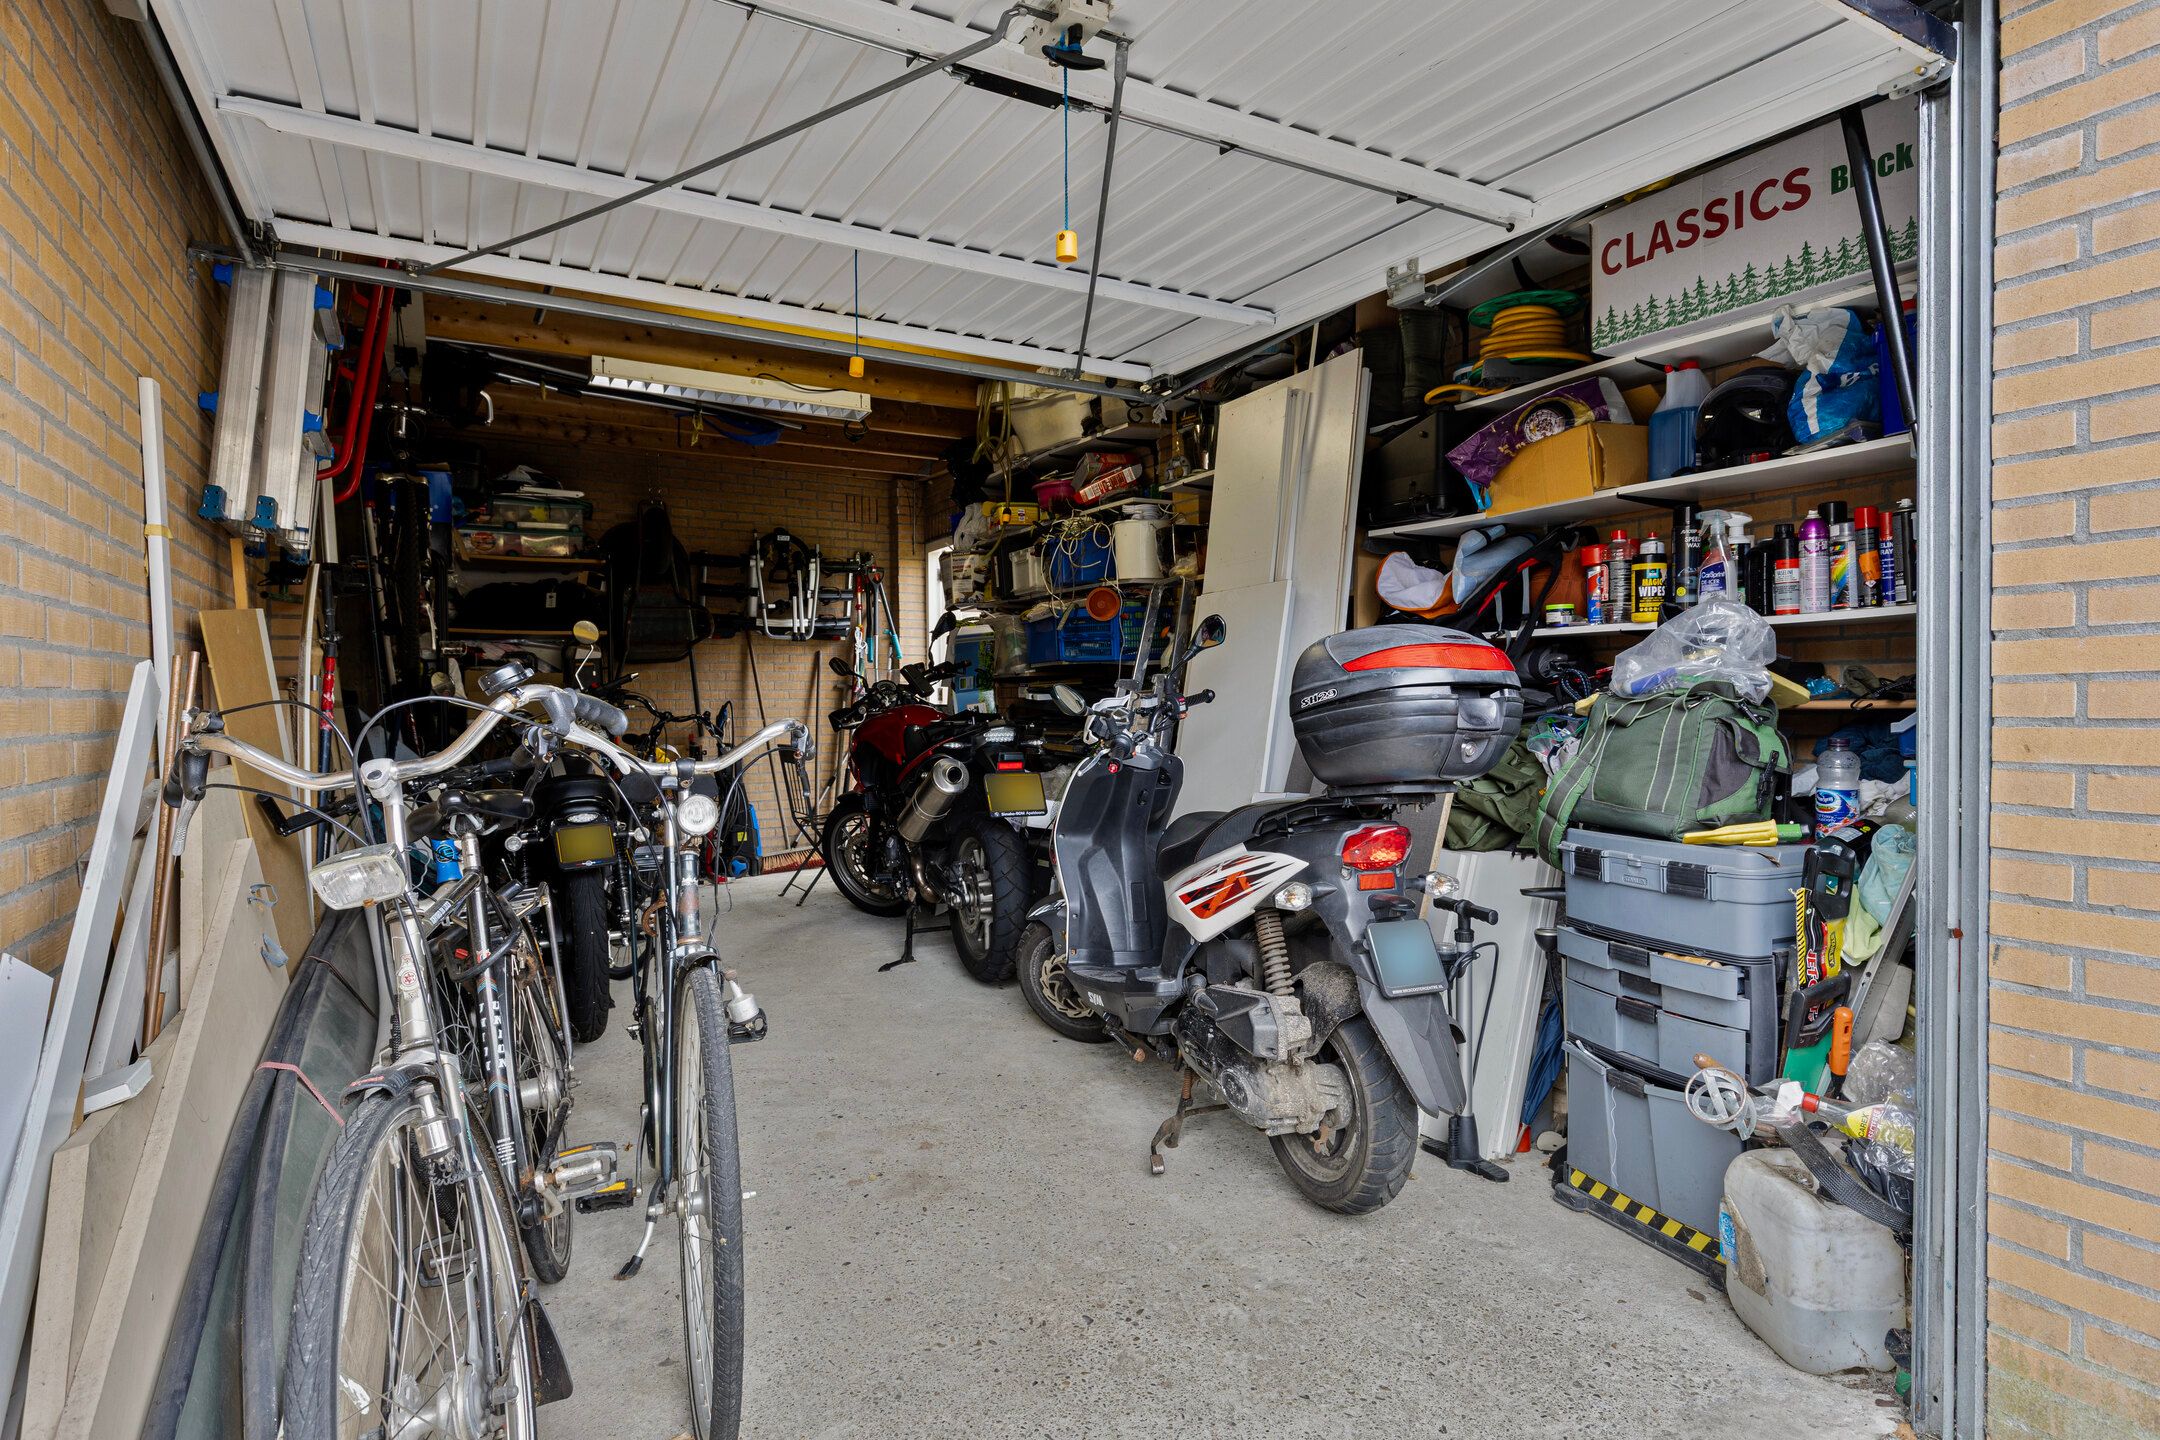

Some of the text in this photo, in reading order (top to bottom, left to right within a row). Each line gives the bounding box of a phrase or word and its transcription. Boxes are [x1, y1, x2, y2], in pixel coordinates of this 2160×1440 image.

[1601, 142, 1915, 276] CLASSICS Bck
[1641, 577, 1662, 586] MAGIC
[1638, 585, 1665, 597] WIPES
[1858, 1113, 1870, 1137] CAREX
